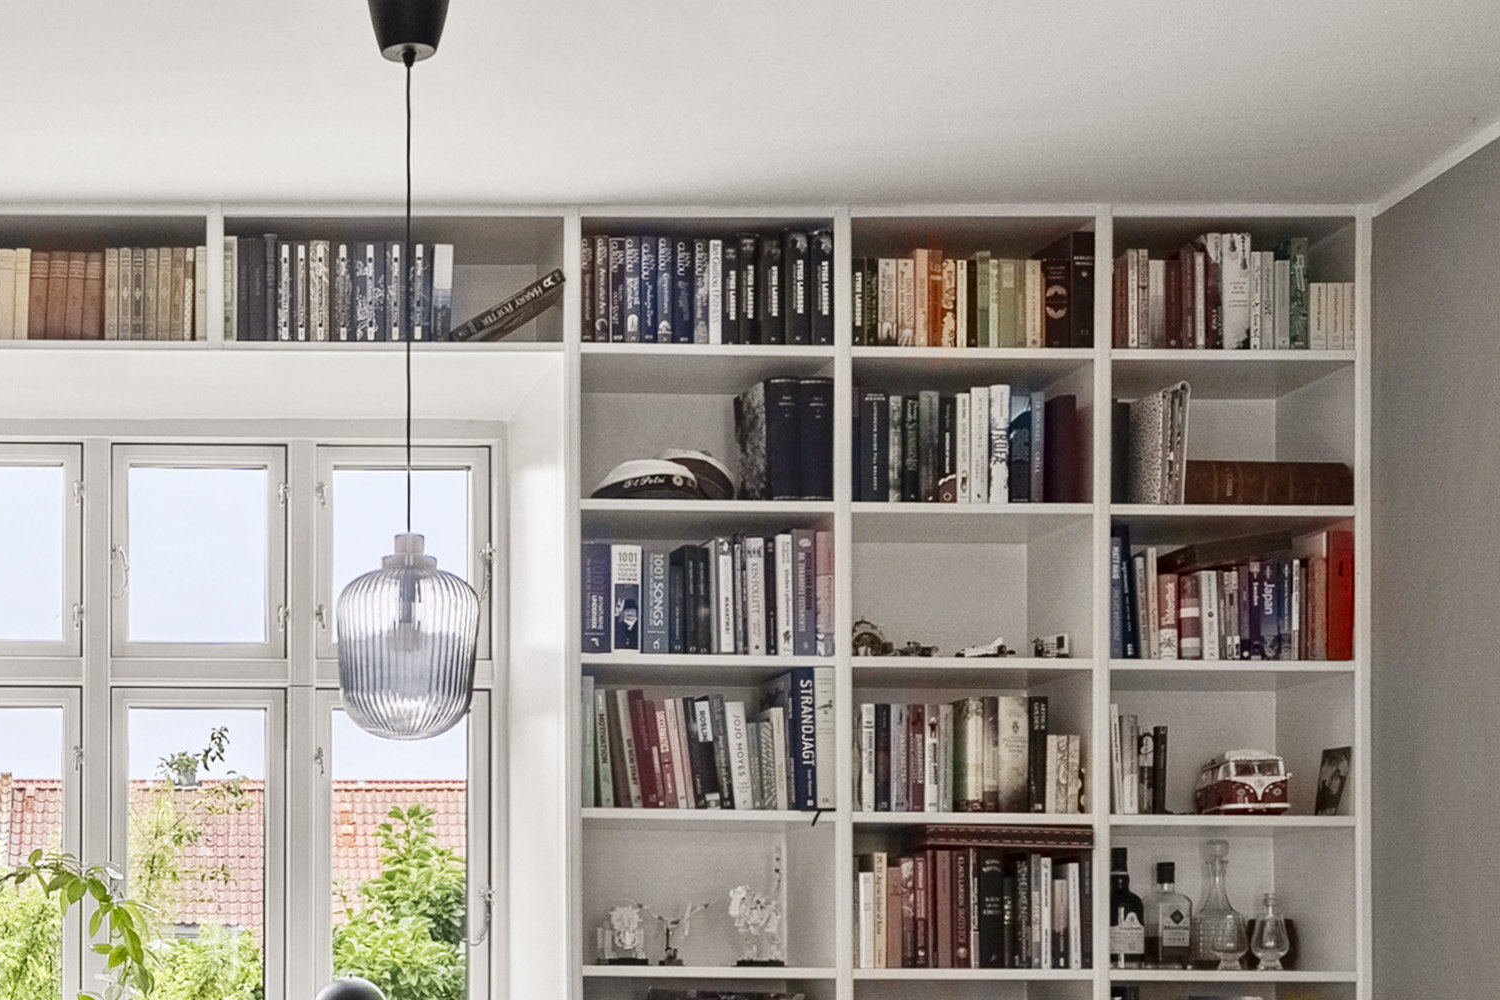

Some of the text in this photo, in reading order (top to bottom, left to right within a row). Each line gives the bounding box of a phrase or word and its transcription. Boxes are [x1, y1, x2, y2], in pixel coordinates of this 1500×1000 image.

[480, 285, 544, 327] HARRY POTTER
[618, 552, 638, 563] 1001
[653, 553, 664, 627] 1001 SONGS
[751, 563, 761, 614] KEN FOLLETT
[1262, 582, 1275, 616] Japan
[597, 712, 609, 764] MOTIVATION
[732, 713, 747, 777] JOJO MOYES
[799, 679, 815, 767] STRANDJAGT
